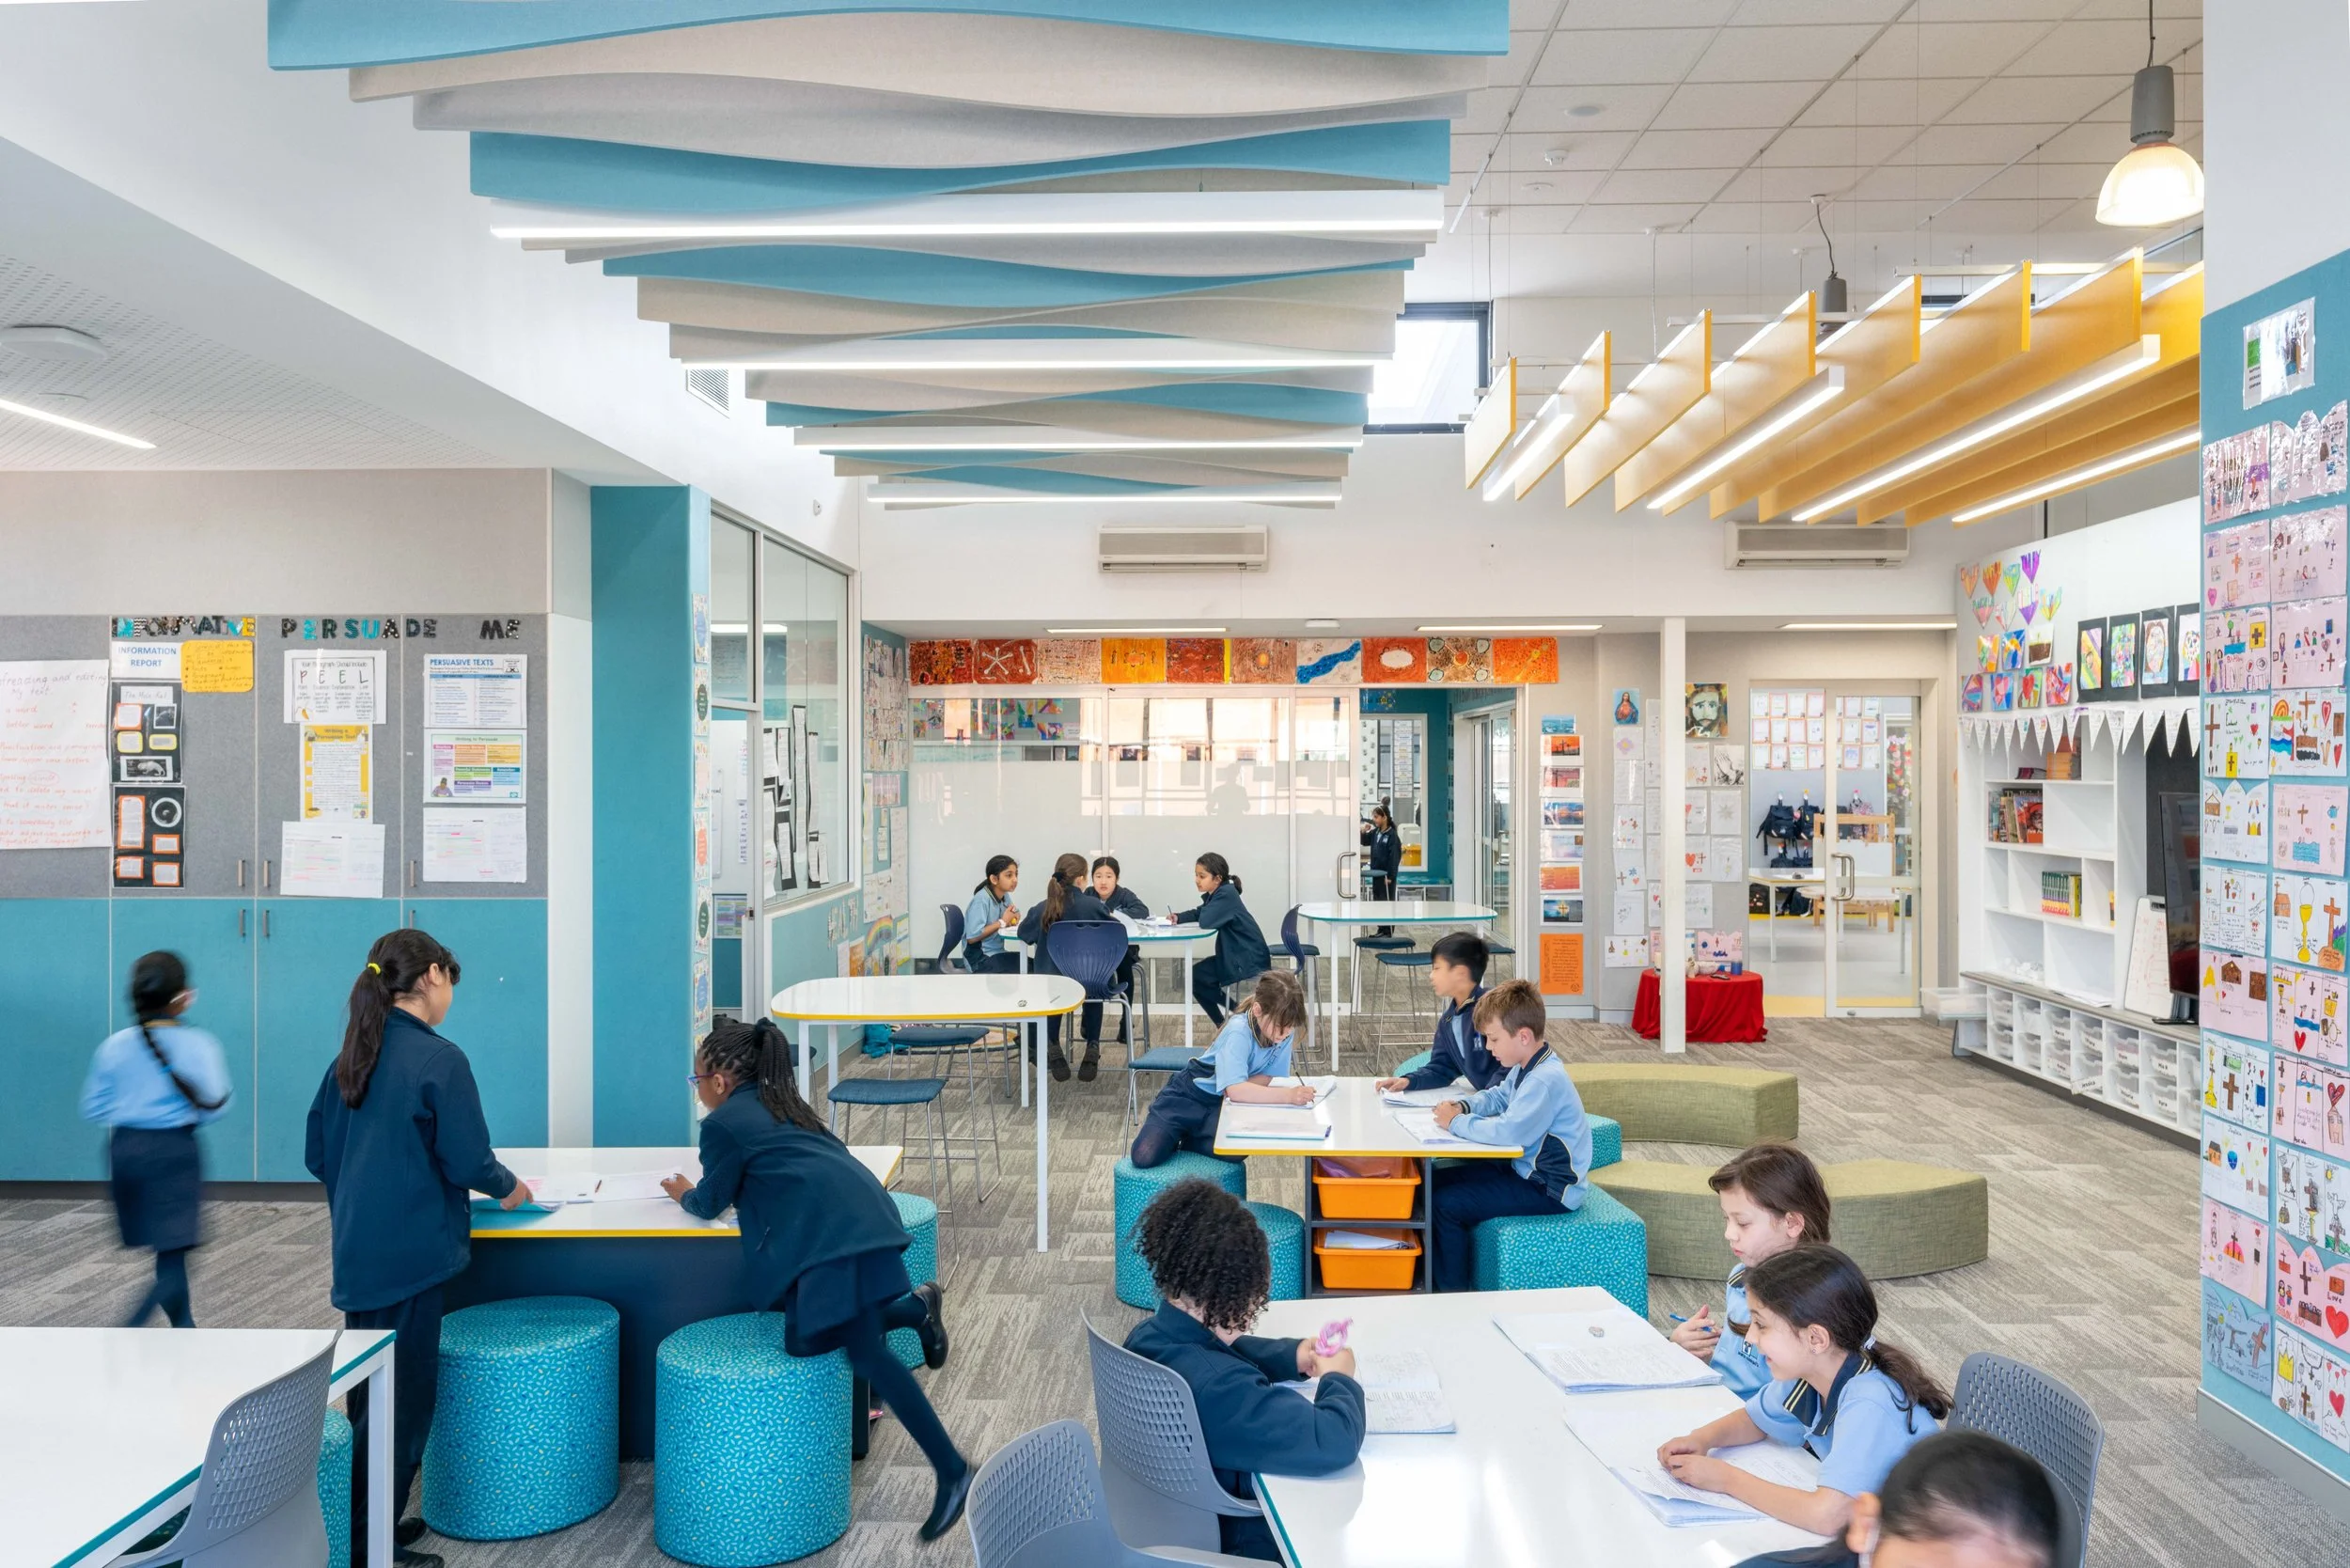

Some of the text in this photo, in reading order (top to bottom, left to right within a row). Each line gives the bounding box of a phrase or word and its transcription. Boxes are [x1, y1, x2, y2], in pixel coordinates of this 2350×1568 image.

[281, 619, 521, 640] PERSUADE ME
[118, 647, 177, 655] INFORMATION
[300, 670, 368, 683] P E E L
